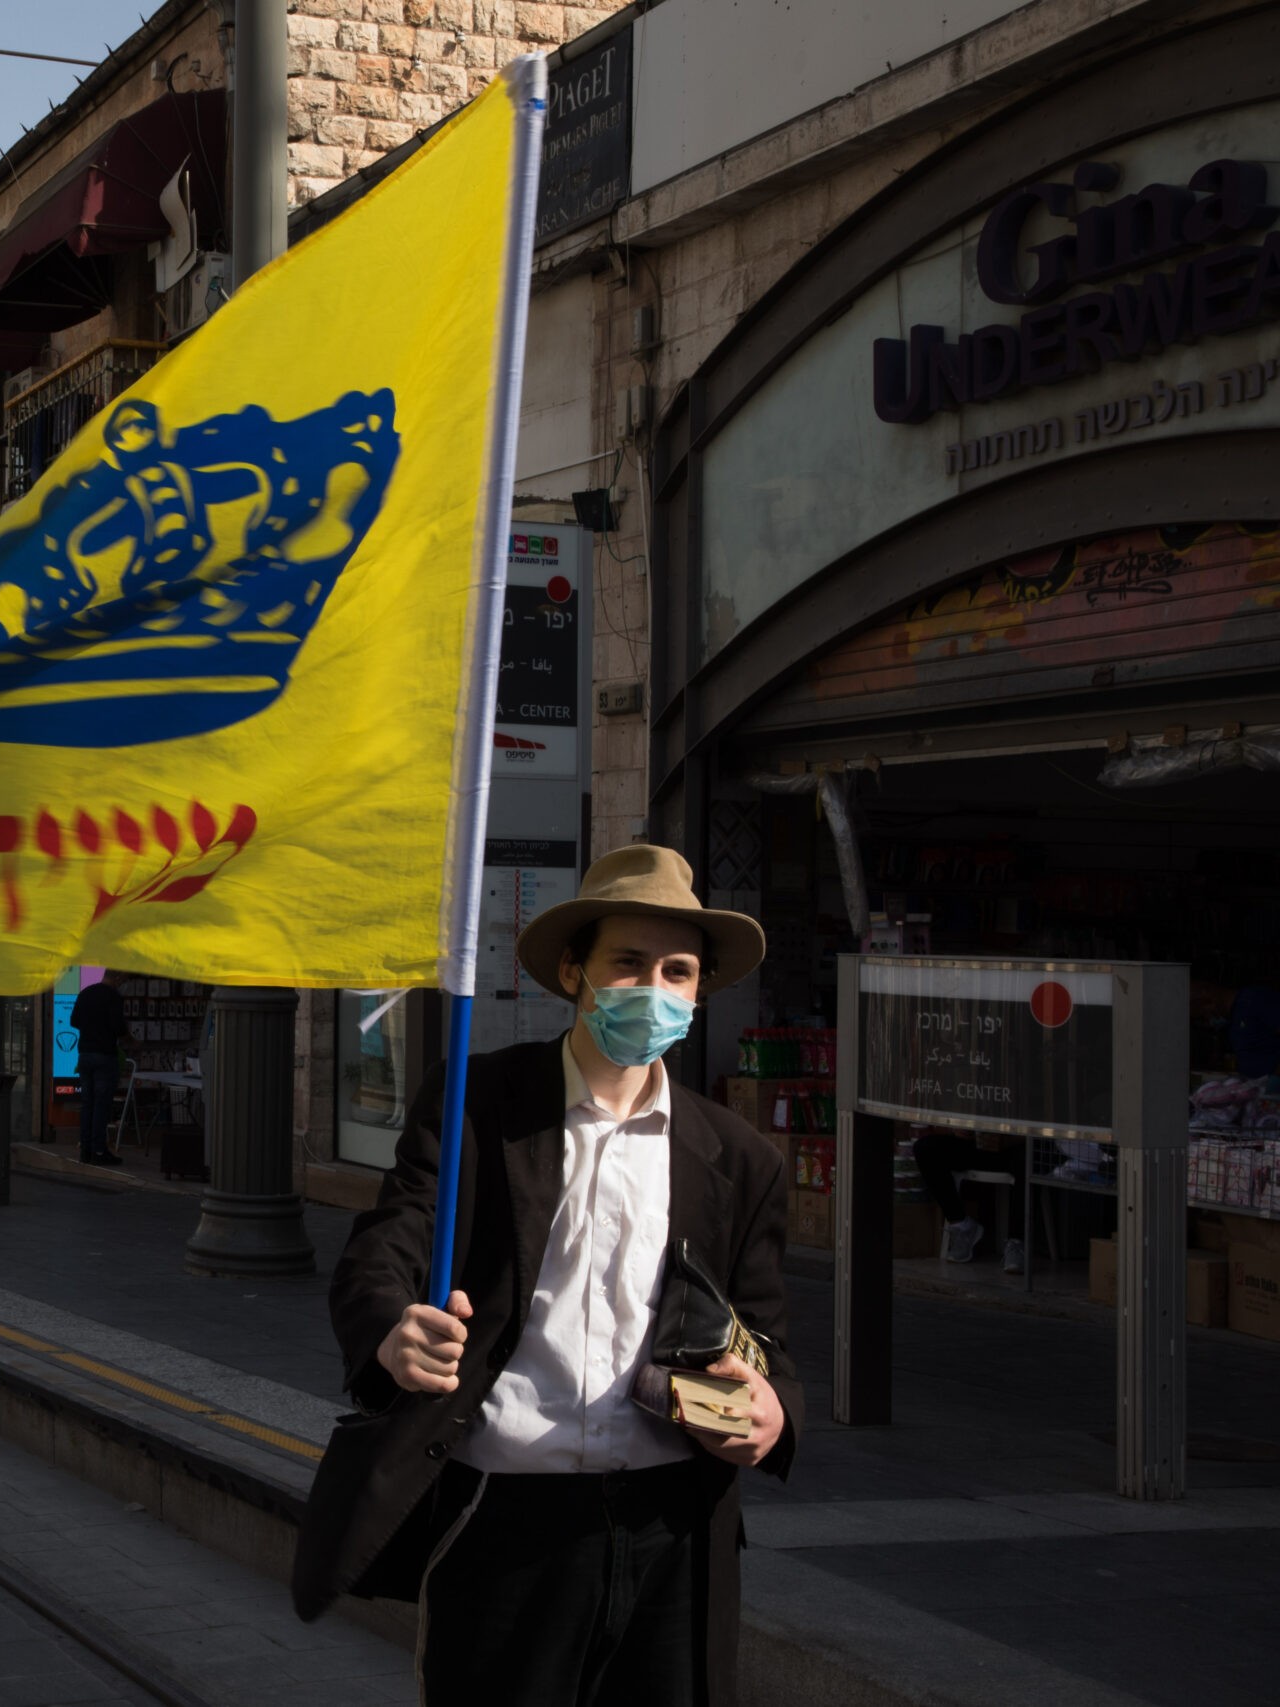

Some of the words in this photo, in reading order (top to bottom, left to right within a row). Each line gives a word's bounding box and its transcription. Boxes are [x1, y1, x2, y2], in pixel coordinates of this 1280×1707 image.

[545, 46, 616, 131] PIAGET
[977, 158, 1280, 305] Gina
[1217, 358, 1280, 408] ינה
[1073, 379, 1204, 443] הלבשה
[945, 416, 1063, 475] תחתונה
[544, 611, 573, 629] יפו
[520, 703, 571, 719] CENTER
[917, 1011, 952, 1031] מרכז
[976, 1015, 1002, 1034] יפו
[907, 1077, 943, 1096] JAFFA
[956, 1082, 1012, 1103] CENTER
